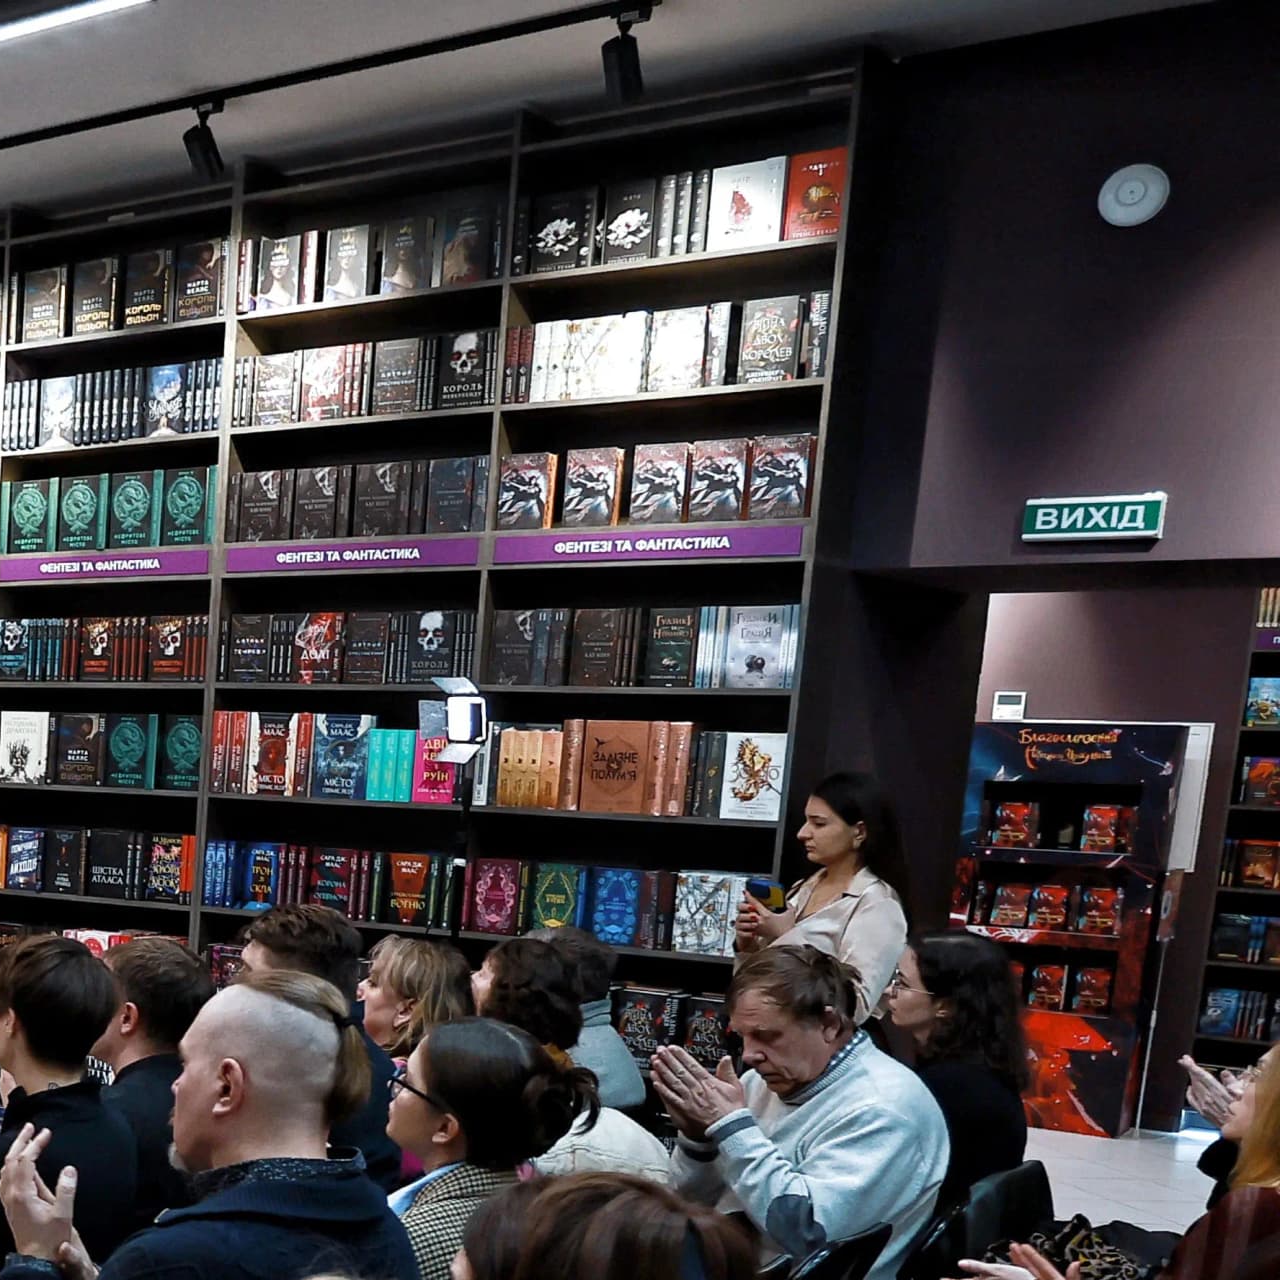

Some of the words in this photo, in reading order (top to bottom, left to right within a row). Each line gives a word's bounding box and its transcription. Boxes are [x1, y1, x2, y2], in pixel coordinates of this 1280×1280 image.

[742, 346, 793, 362] КОРОЛЕВ
[442, 383, 483, 393] КОРОЛЬ
[1035, 505, 1146, 530] ВИХІД
[553, 539, 611, 554] ФЕНТЕЗІ
[613, 539, 632, 552] ТА
[634, 535, 731, 552] ФАНТАСТИКА
[276, 551, 324, 564] ФЕНТЕЗІ
[326, 550, 340, 562] ТА
[342, 548, 421, 561] ФАНТАСТИКА
[40, 562, 80, 574] ФЕНТЕЗІ
[82, 561, 94, 572] ТА
[95, 558, 161, 571] ФАНТАСТИКА
[301, 649, 330, 660] ДОЛІ
[263, 728, 286, 736] МААС
[330, 728, 354, 736] МААС
[258, 775, 285, 784] МІСТО
[423, 771, 449, 781] РУЇН
[324, 778, 353, 786] МІСТО
[92, 866, 123, 876] ШІСТКА
[252, 865, 273, 876] ТРОН
[92, 875, 123, 885] АТЛАСА
[390, 898, 425, 910] ВОГНЮ
